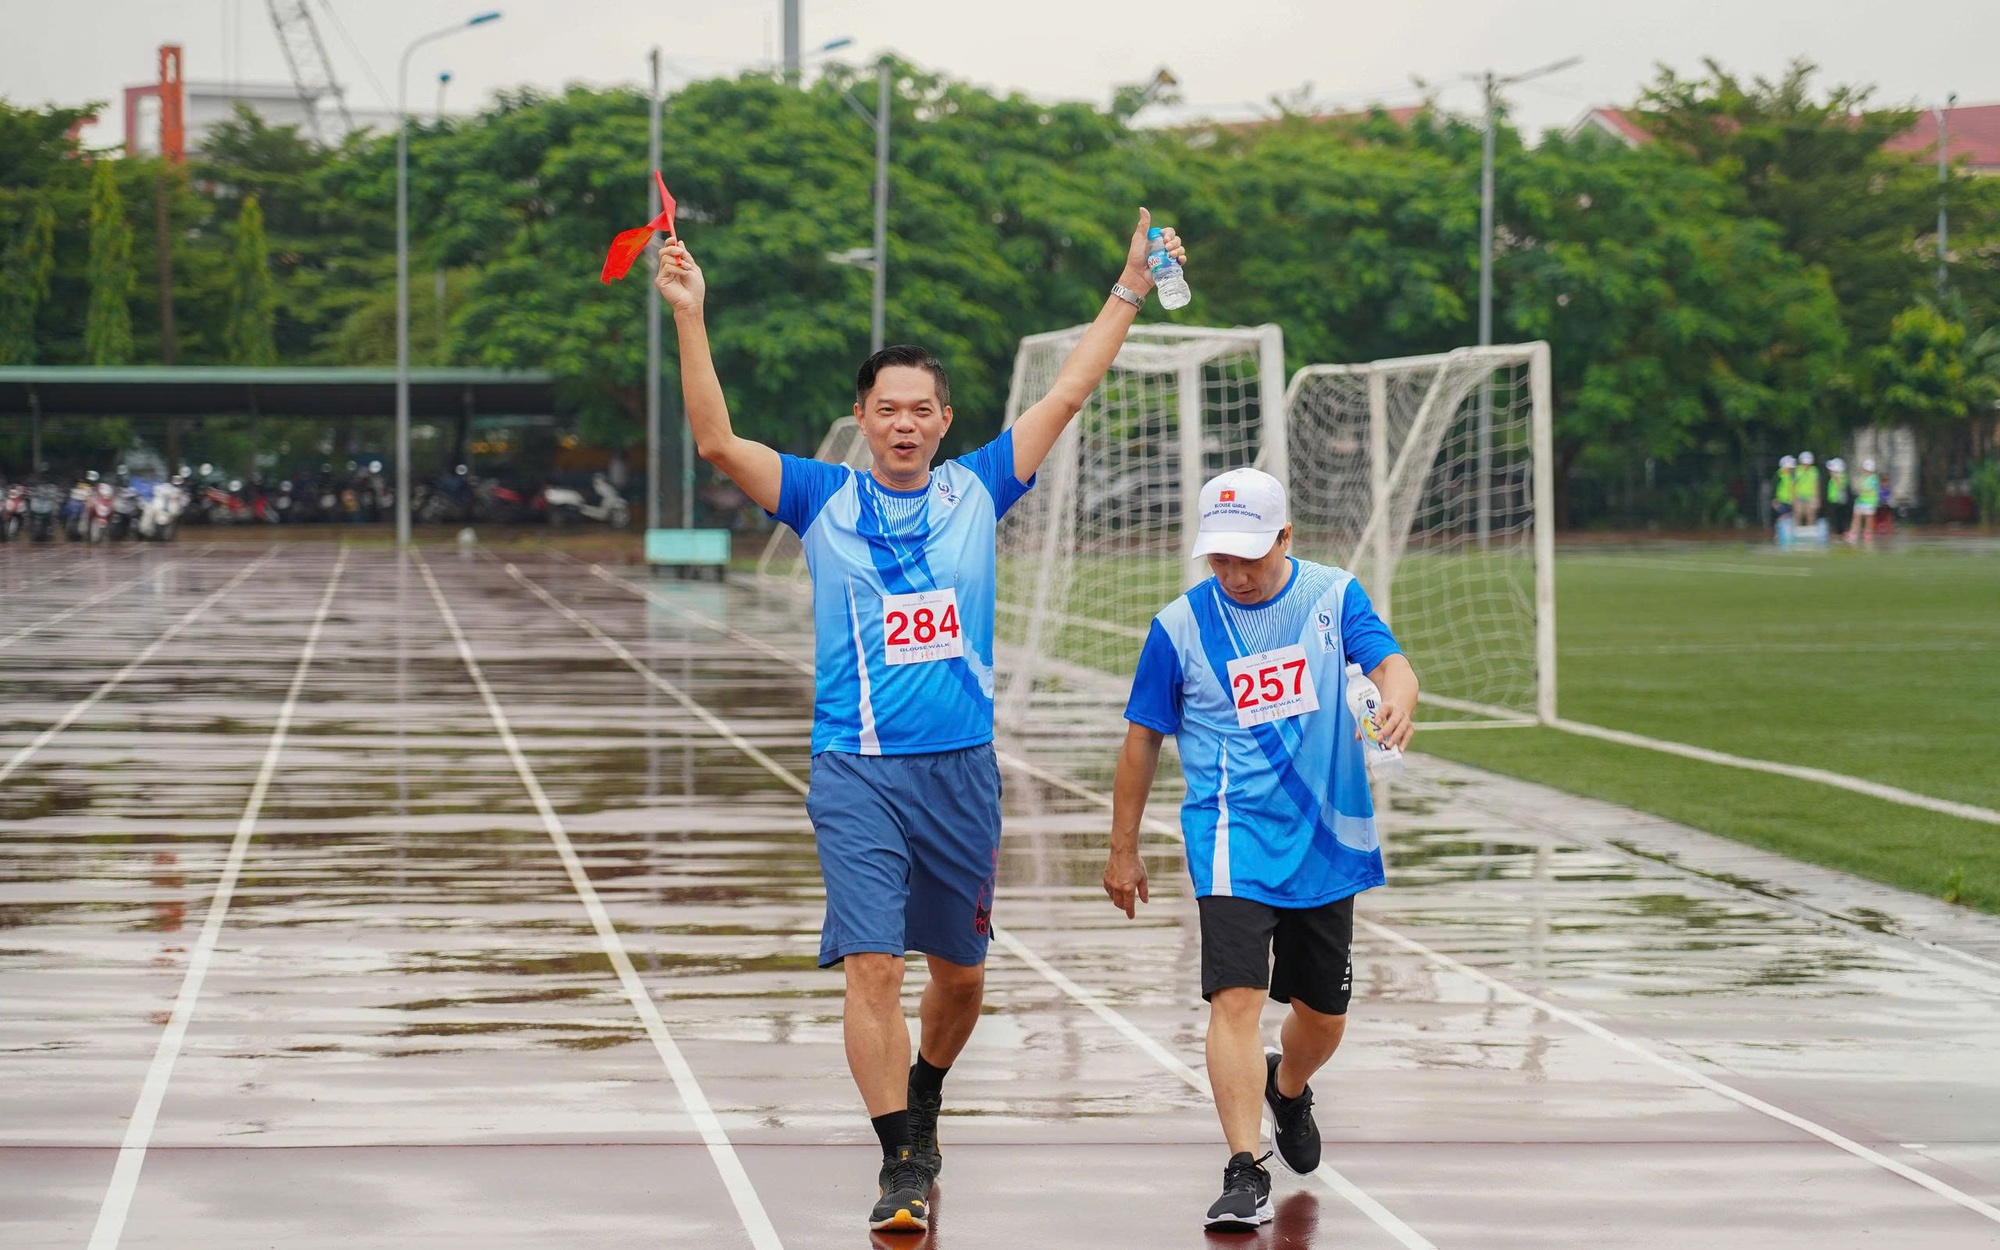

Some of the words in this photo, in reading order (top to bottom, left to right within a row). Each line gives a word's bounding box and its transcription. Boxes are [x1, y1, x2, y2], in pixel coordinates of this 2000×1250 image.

[1240, 510, 1261, 520] HOSPITAL
[886, 604, 959, 646] 284
[1233, 659, 1306, 709] 257
[1250, 704, 1278, 713] BLOUSE
[1278, 698, 1301, 706] WALK
